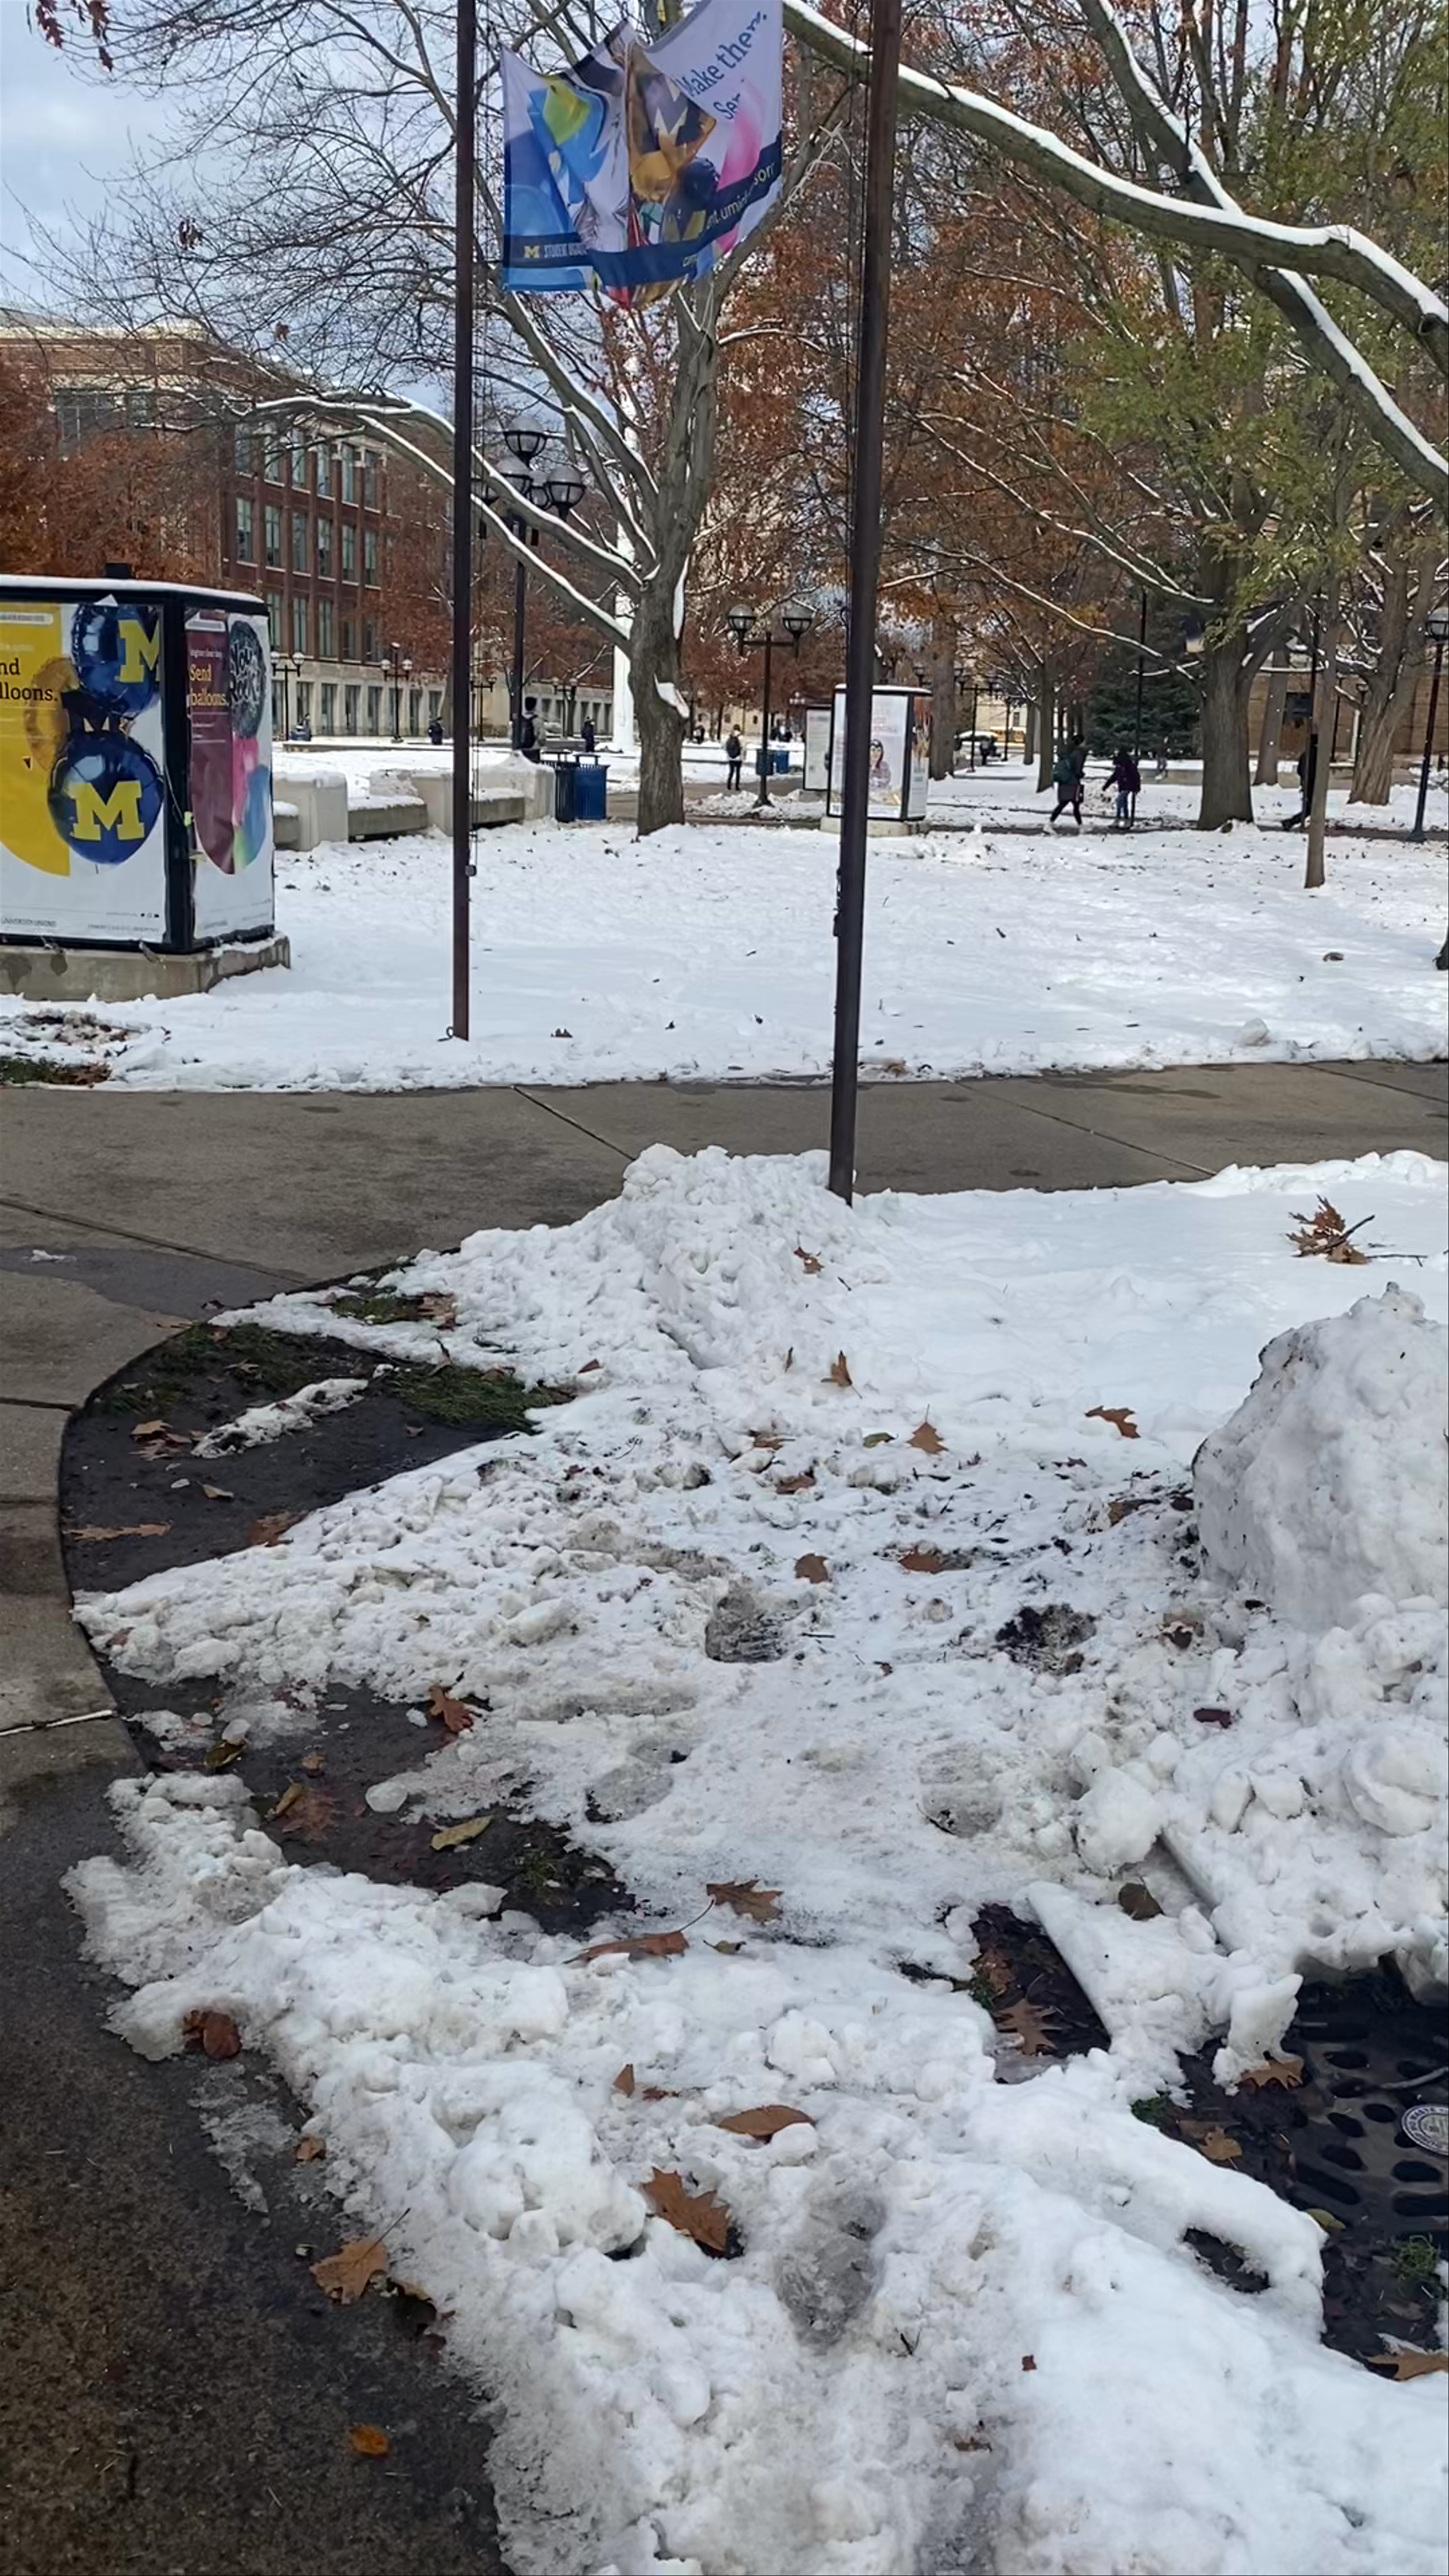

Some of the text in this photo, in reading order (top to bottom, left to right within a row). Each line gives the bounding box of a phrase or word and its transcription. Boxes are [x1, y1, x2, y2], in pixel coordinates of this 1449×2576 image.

[525, 246, 539, 258] M
[190, 664, 212, 681] Send
[65, 780, 145, 840] M
